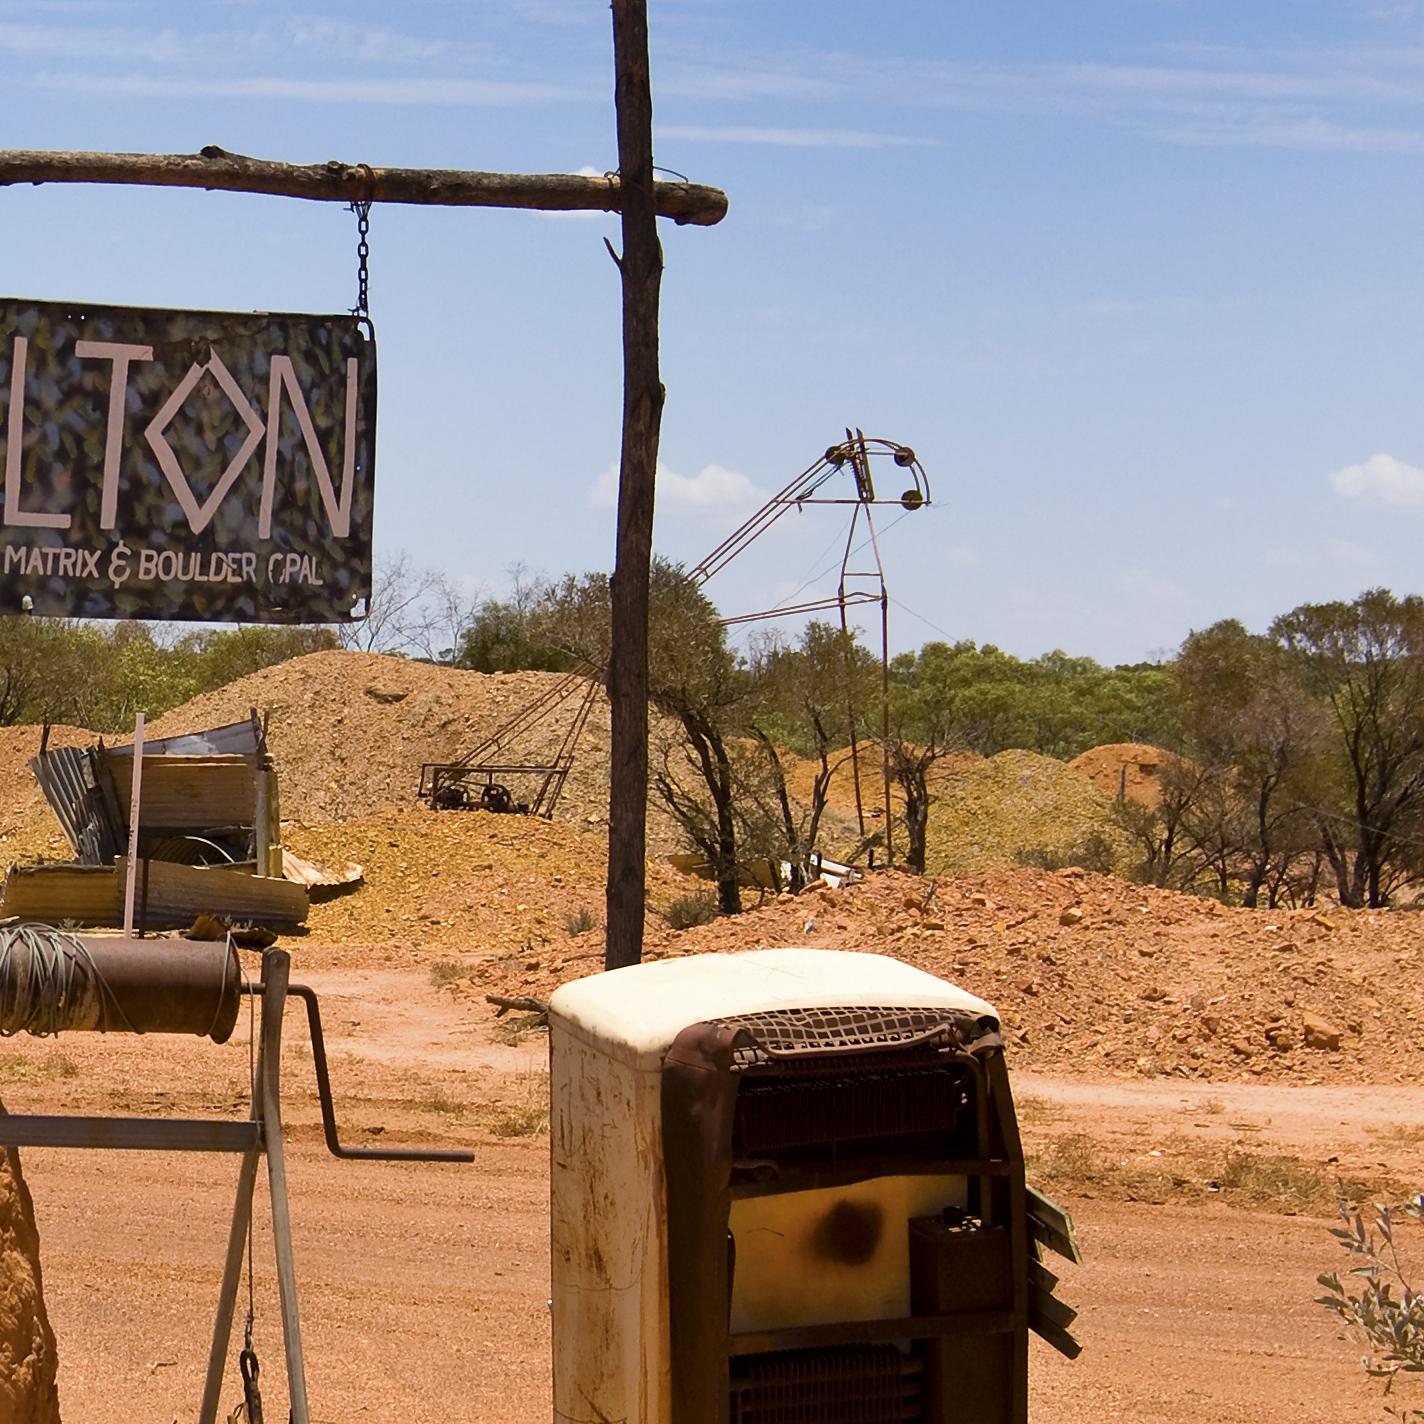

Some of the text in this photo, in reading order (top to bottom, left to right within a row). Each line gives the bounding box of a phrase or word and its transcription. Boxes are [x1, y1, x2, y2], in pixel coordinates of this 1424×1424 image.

[4, 544, 102, 578] MATRIX
[108, 540, 132, 589] &
[139, 549, 256, 582] BOULDER
